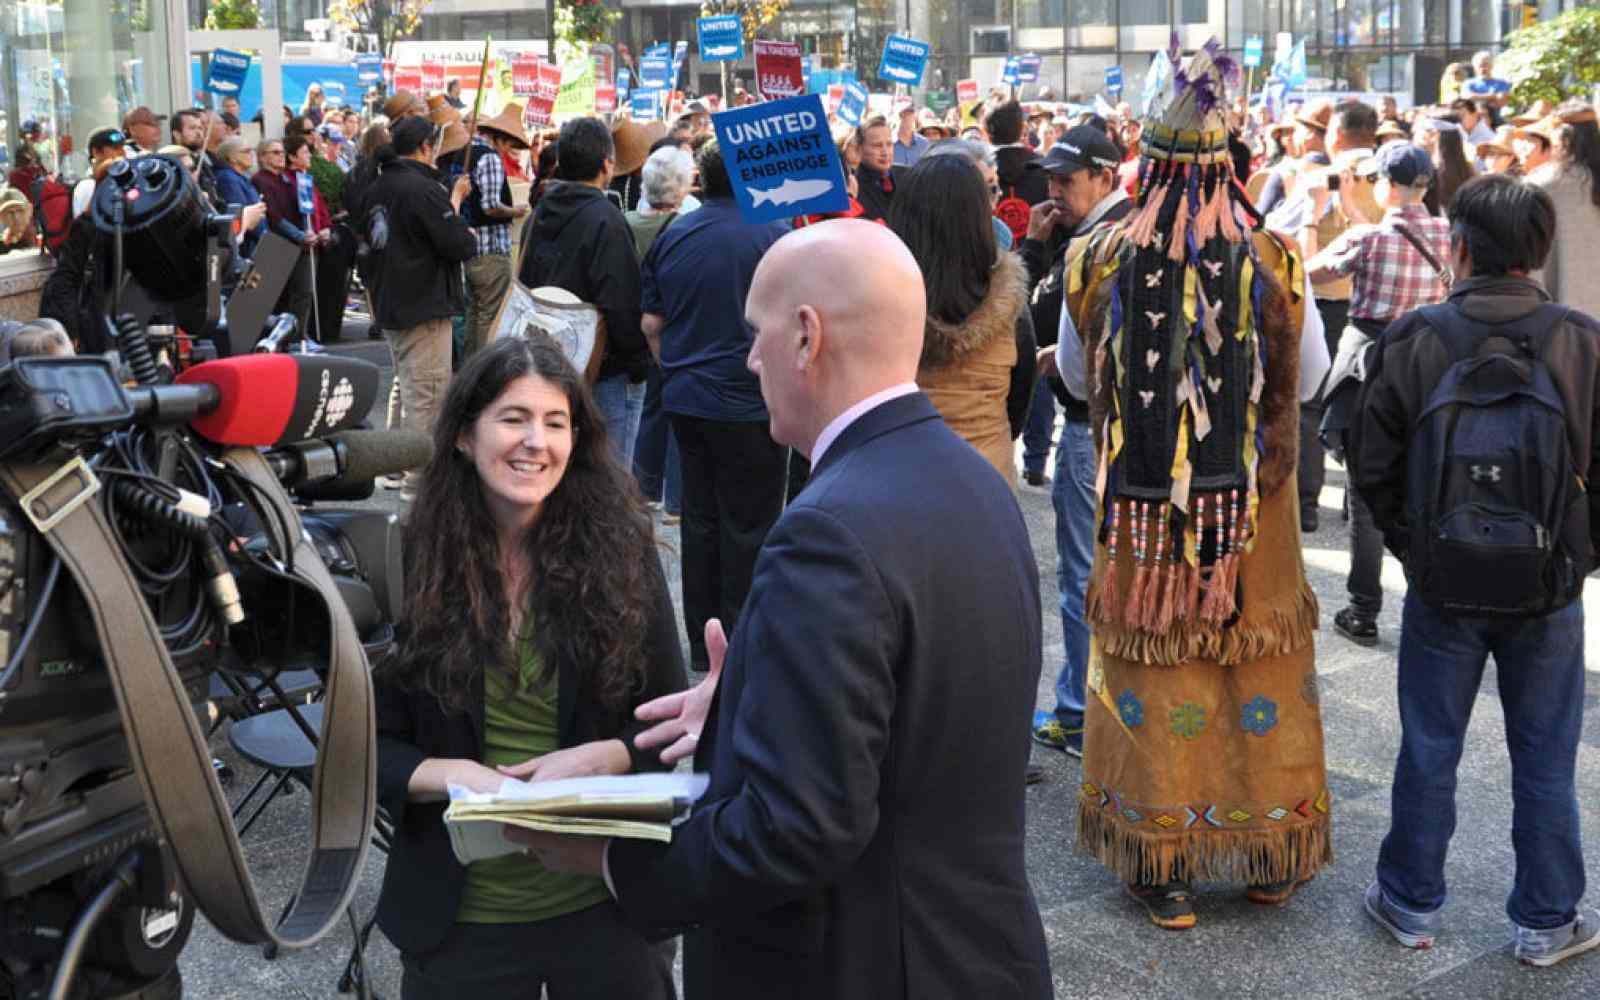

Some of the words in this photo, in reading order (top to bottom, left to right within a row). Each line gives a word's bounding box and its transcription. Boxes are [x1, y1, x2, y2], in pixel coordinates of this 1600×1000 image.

[702, 20, 737, 31] UNITED
[890, 40, 925, 56] UNITED
[725, 111, 816, 144] UNITED
[736, 133, 822, 164] AGAINST
[740, 153, 830, 181] ENBRIDGE
